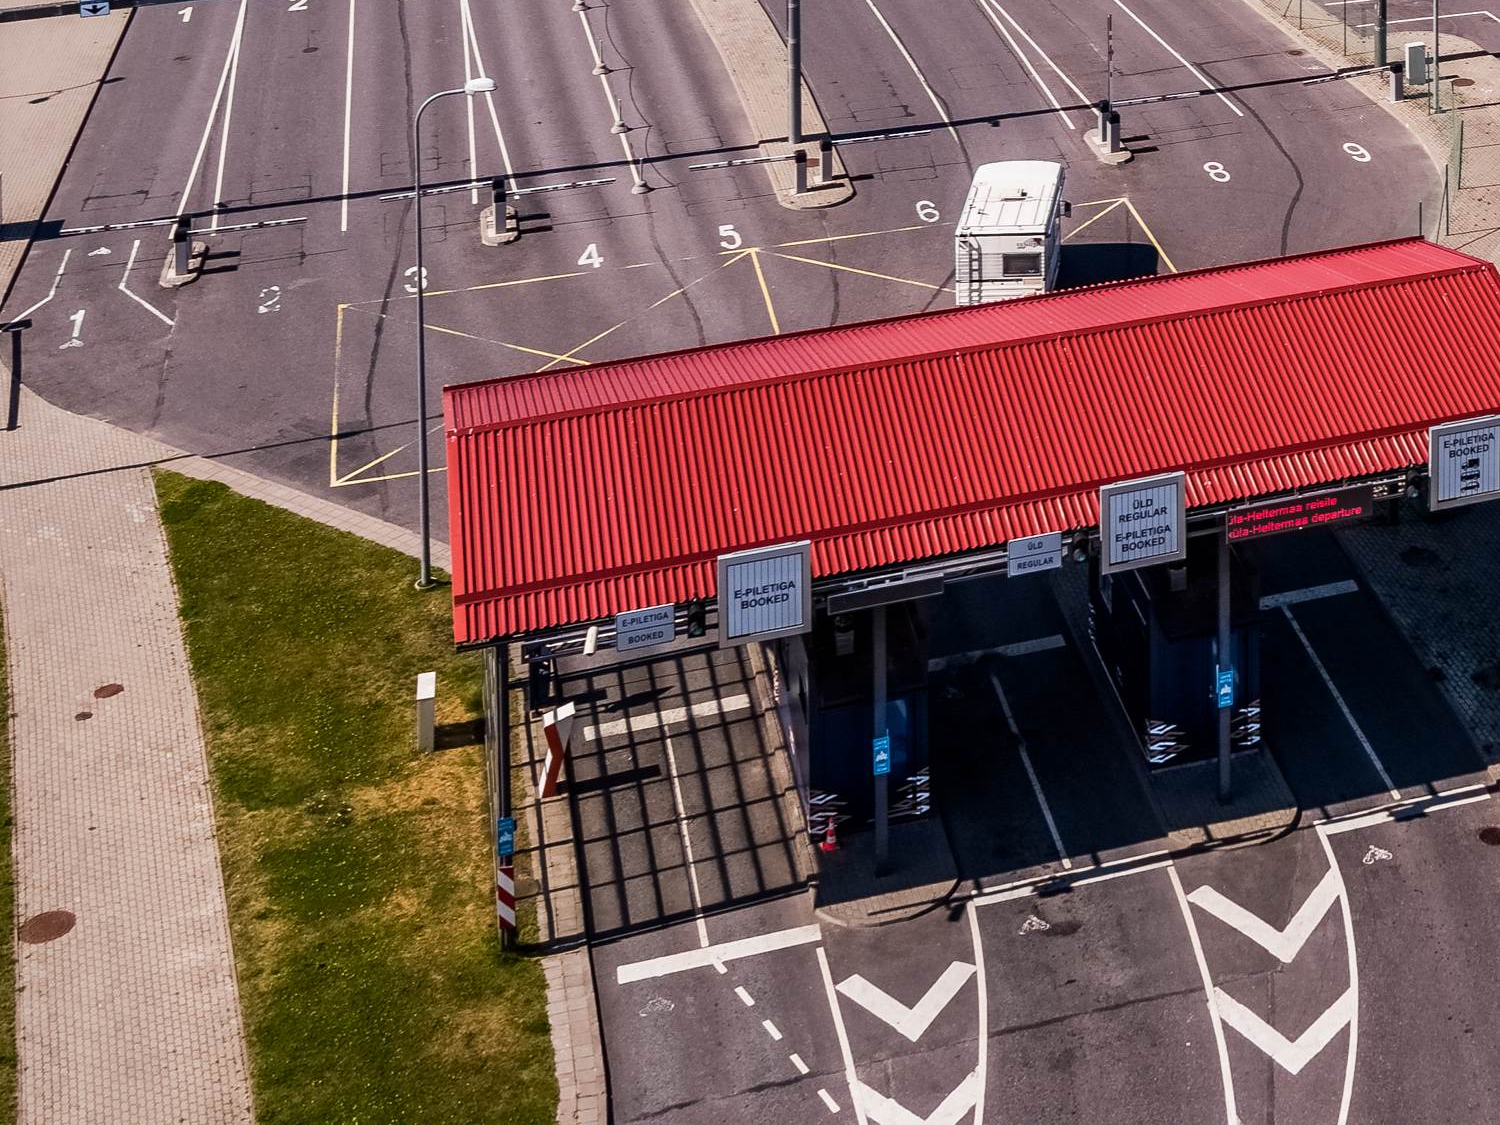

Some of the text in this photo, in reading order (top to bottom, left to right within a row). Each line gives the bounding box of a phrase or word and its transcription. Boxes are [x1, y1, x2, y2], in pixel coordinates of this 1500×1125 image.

[178, 7, 193, 23] 1
[1342, 141, 1371, 163] 9
[1203, 161, 1231, 183] 8
[915, 200, 940, 222] 6
[718, 225, 742, 250] 5
[577, 243, 604, 268] 4
[403, 266, 428, 293] 3
[258, 286, 281, 313] 2
[69, 309, 86, 338] 1
[1443, 432, 1495, 449] E-PILETIGA
[1449, 444, 1490, 458] BOOKED
[1132, 498, 1153, 510] ÜLD
[1118, 506, 1168, 523] REGULAR
[1311, 505, 1362, 523] departure
[1115, 524, 1172, 543] E-PILETIGA
[1027, 541, 1043, 551] ÜLD
[1121, 536, 1166, 552] BOOKED
[1017, 556, 1054, 570] REGULAR
[734, 580, 796, 599] E-PILETIGA
[740, 592, 790, 610] BOOKED
[622, 611, 669, 627] E-PILETIGA
[628, 630, 664, 644] BOOKED
